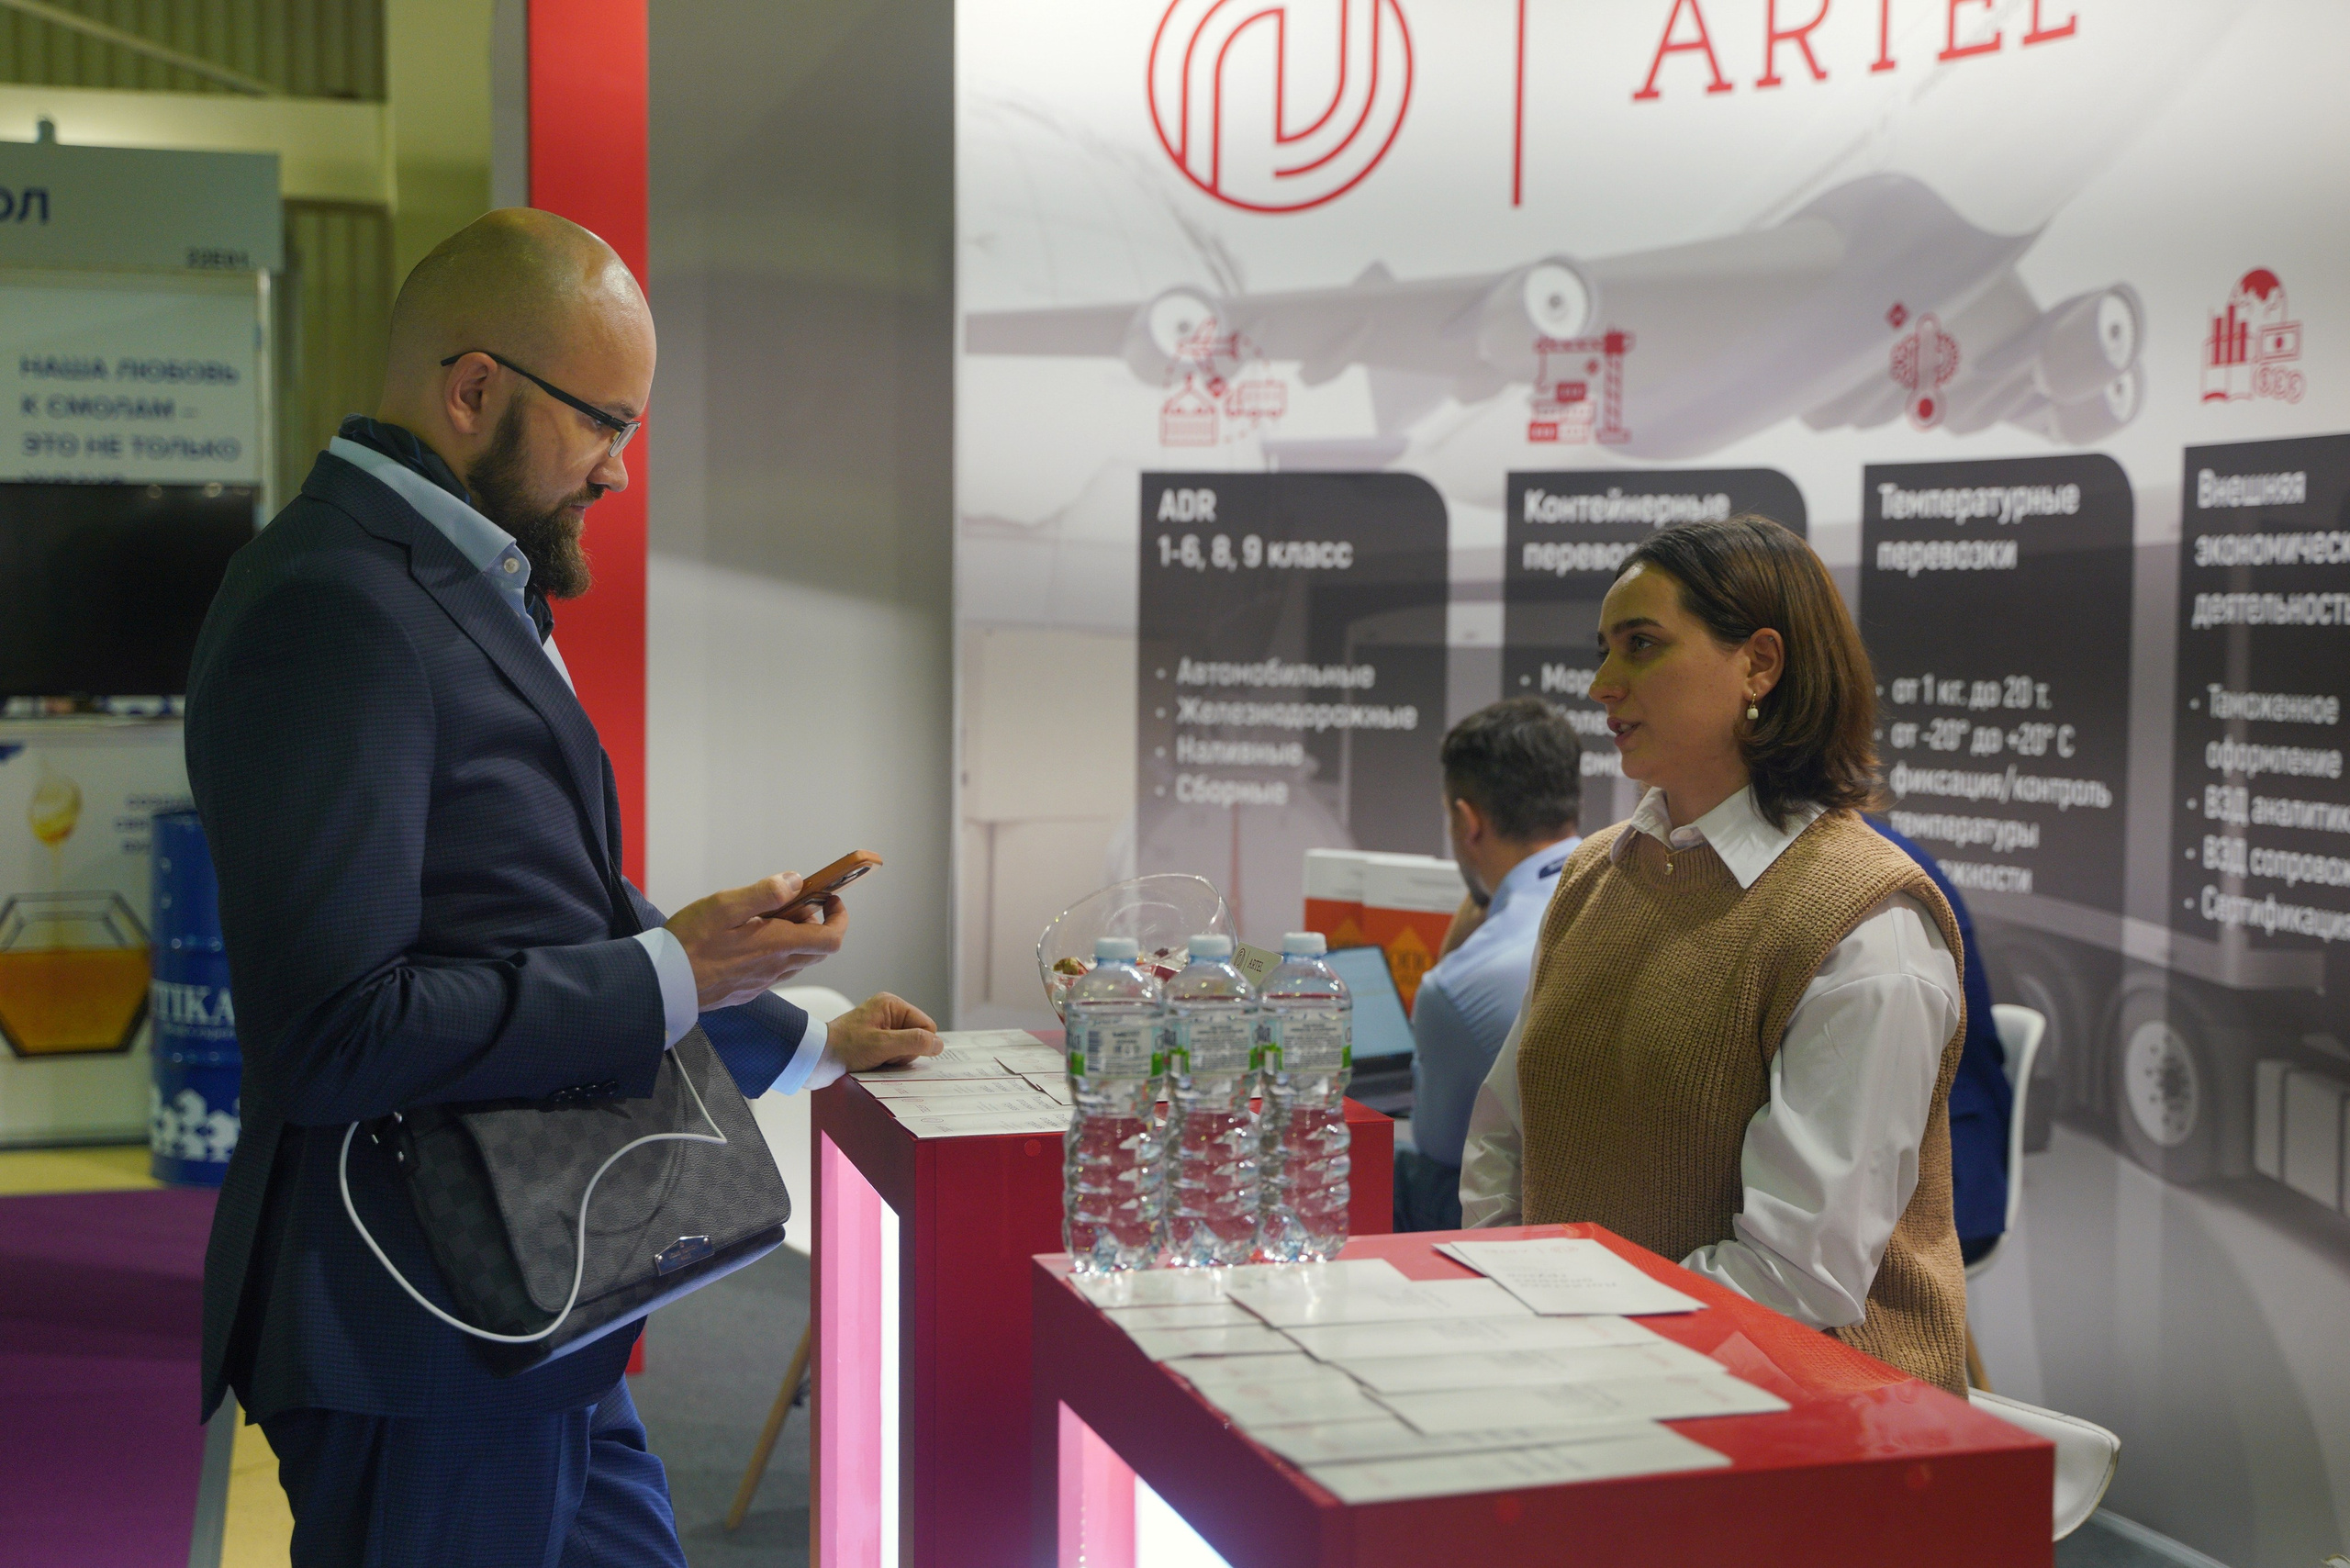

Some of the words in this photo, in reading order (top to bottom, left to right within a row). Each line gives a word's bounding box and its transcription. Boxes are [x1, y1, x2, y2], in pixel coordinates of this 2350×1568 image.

[20, 355, 108, 381] НАША
[117, 357, 240, 385] ЛЮБОВЬ
[20, 394, 39, 418] К
[46, 394, 175, 420] СМОЛАМ
[22, 431, 79, 458] ЭТО
[84, 434, 122, 458] НЕ
[131, 435, 241, 461] ТОЛЬКО
[1158, 487, 1217, 522] ADR
[1877, 482, 2081, 525] Температурные
[2198, 468, 2307, 509] Внешняя
[1524, 487, 1730, 528] Контейнерные
[1158, 533, 1206, 572] 1-6,
[1211, 533, 1237, 572] 8,
[1242, 533, 1263, 568] 9
[1267, 541, 1354, 569] класс
[1876, 540, 2019, 577] перевозки
[1176, 655, 1376, 689] Автомобильные
[1891, 678, 1920, 705] от
[1921, 672, 1935, 705] 1
[1968, 680, 2002, 711] до
[2002, 674, 2033, 710] 20
[2207, 682, 2340, 725] Таможенное
[1176, 696, 1418, 733] Железнодорожные
[1176, 734, 1305, 767] Наливные
[1890, 722, 1919, 750] от
[1970, 725, 2004, 757] до
[2057, 723, 2076, 758] C
[1176, 773, 1289, 810] Сборные
[1889, 759, 2113, 812] фиксация/контроль
[2204, 783, 2248, 826] ВЭД
[1888, 812, 2041, 854] температуры
[2203, 834, 2247, 879] ВЭД
[1247, 958, 1264, 973] ARTEL
